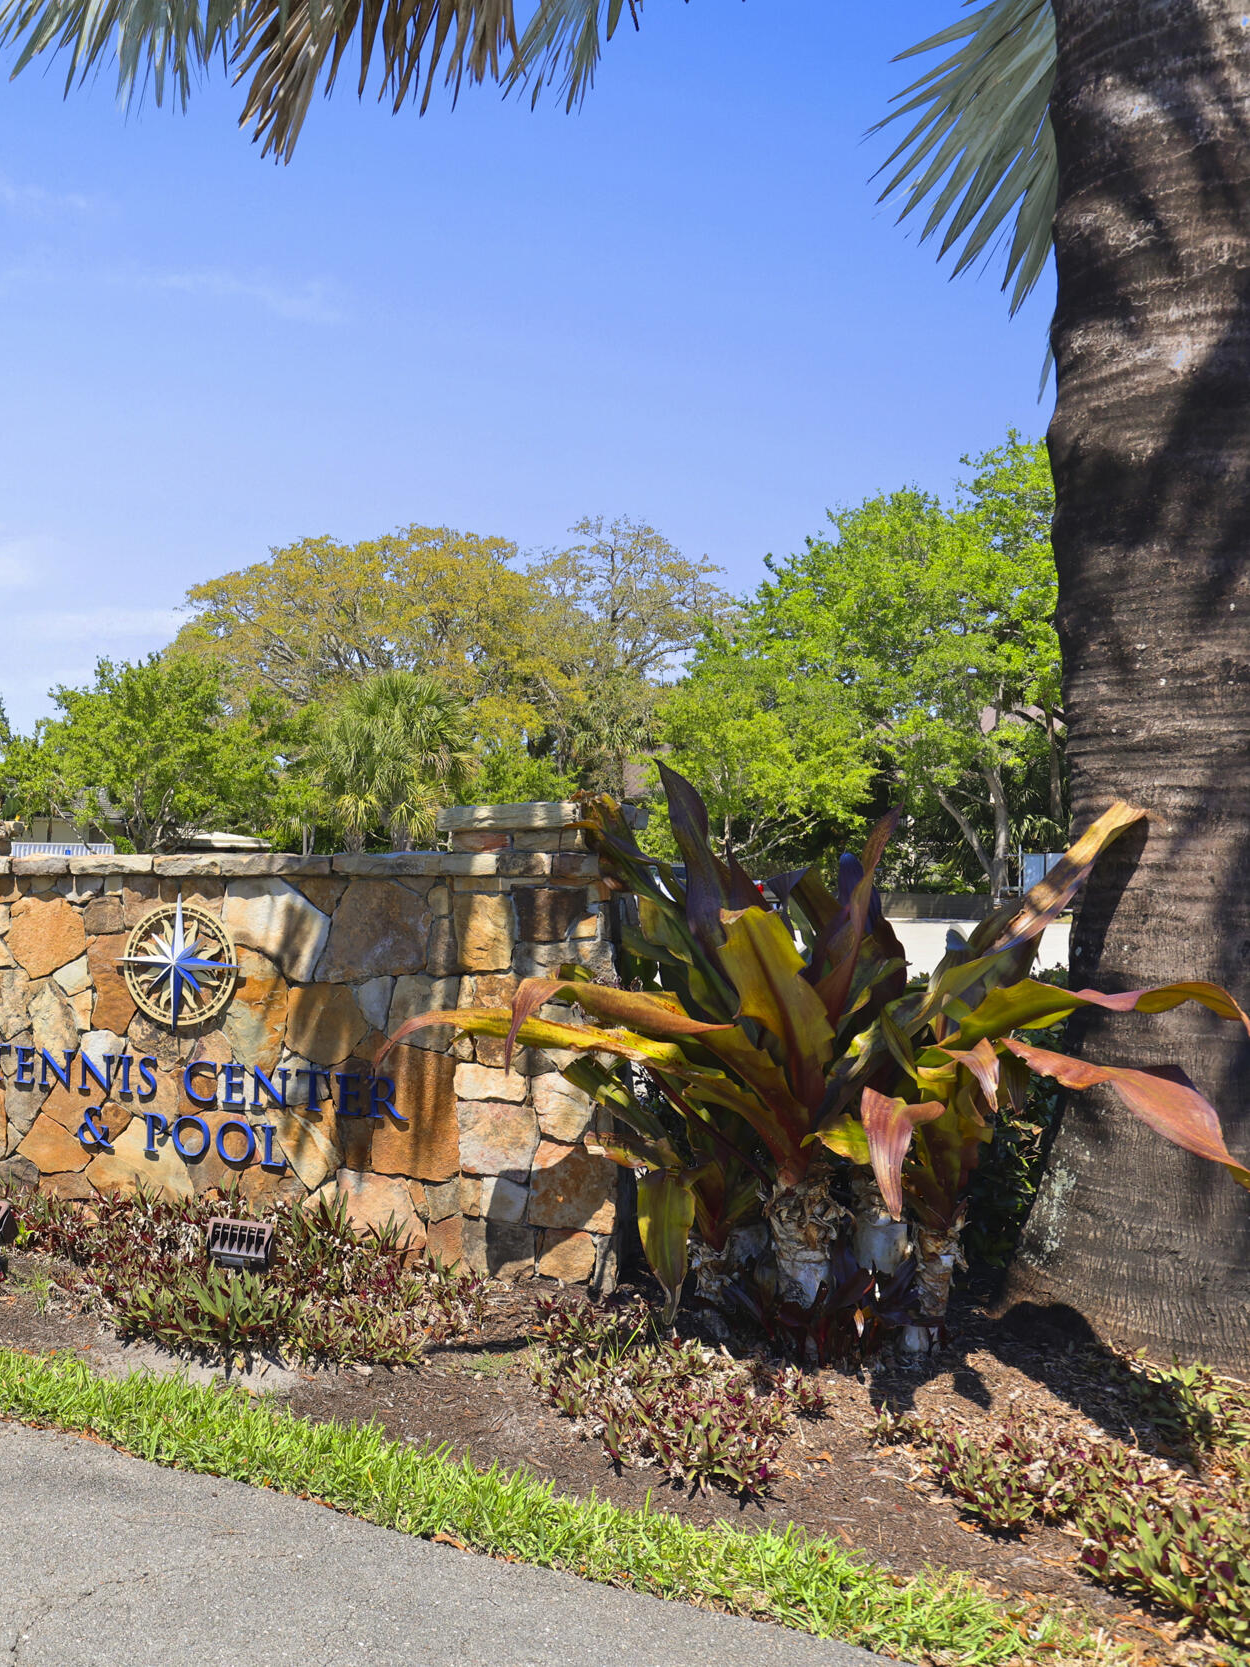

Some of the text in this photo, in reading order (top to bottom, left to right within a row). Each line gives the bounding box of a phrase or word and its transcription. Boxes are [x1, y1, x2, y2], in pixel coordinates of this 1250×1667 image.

[183, 1060, 409, 1121] CENTER
[77, 1105, 287, 1168] & POOL
